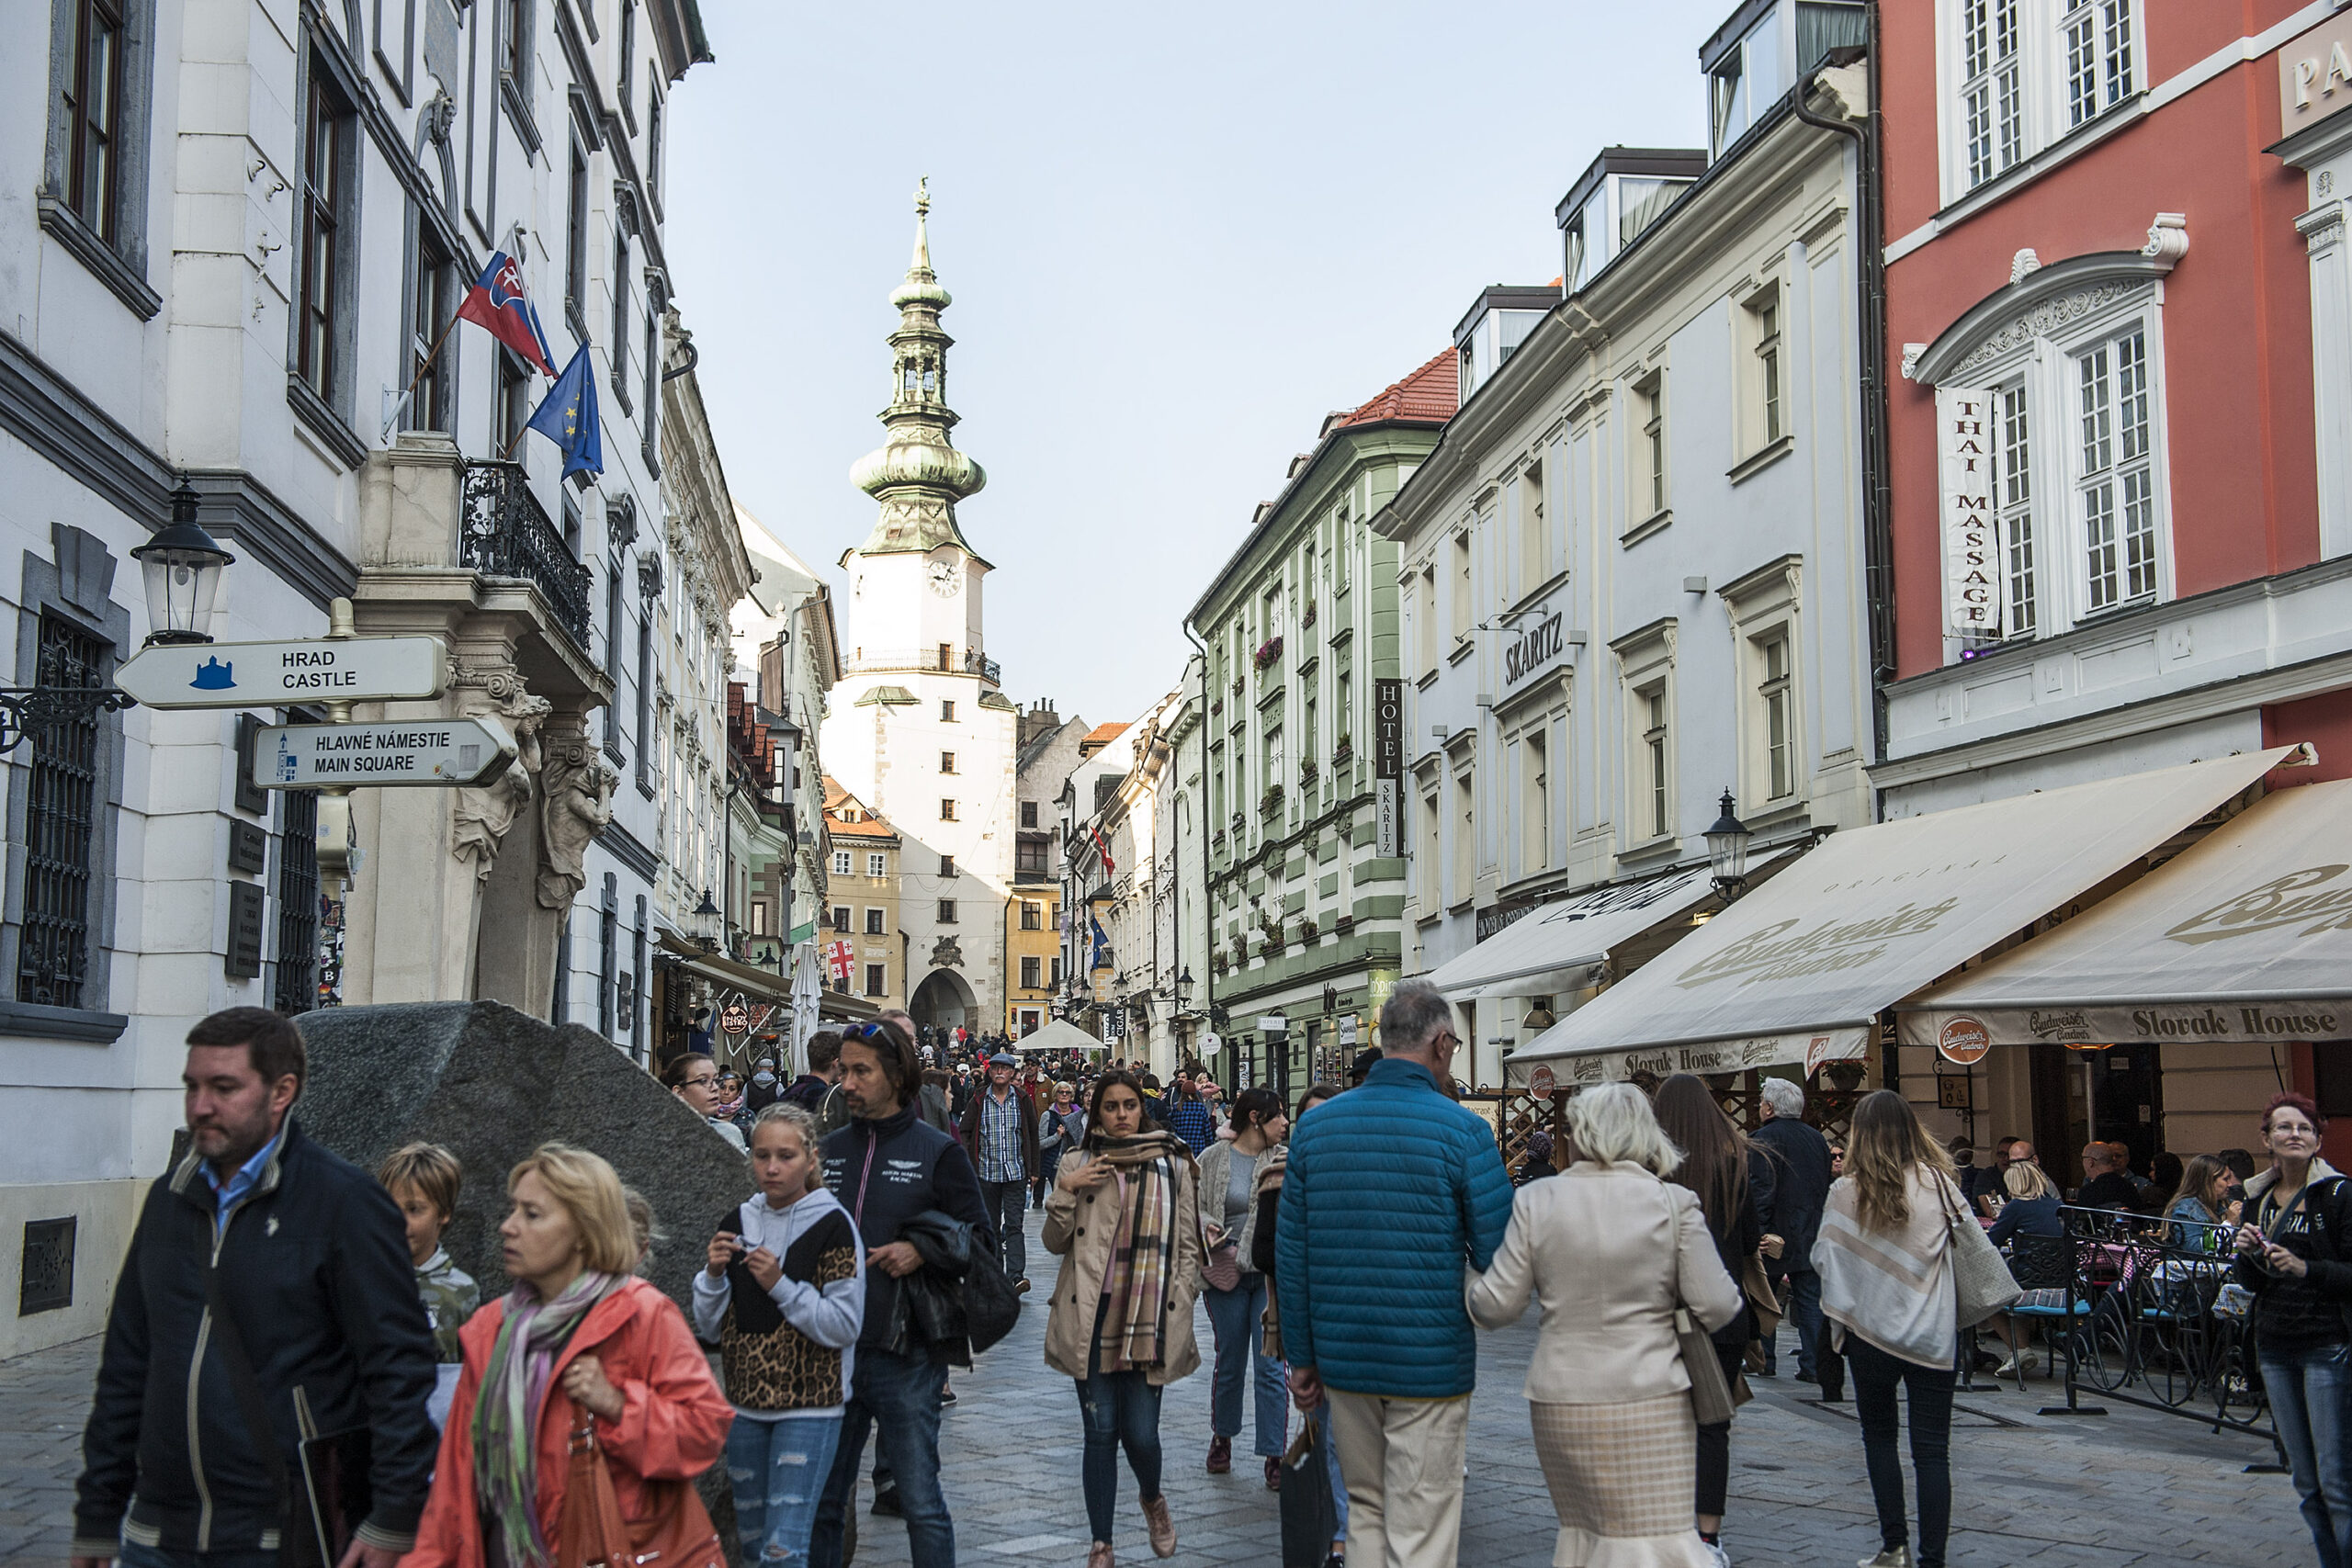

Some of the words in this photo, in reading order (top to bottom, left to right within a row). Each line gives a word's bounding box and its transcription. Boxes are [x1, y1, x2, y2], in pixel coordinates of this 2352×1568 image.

[1955, 400, 1983, 472] THAI
[1957, 494, 1989, 622] MASSAGE
[282, 651, 335, 668] HRAD
[1506, 611, 1562, 686] SKARITZ
[282, 671, 356, 689] CASTLE
[316, 731, 372, 751] HLAVNÉ
[376, 730, 450, 749] NÁMESTIE
[1382, 685, 1396, 775] HOTEL
[315, 757, 350, 773] MAIN
[354, 755, 414, 772] SQUARE
[1383, 784, 1391, 852] SKARITZ
[1115, 1008, 1125, 1037] CIGÁR
[2030, 1010, 2089, 1038] Budweiser
[2132, 1009, 2229, 1036] Slovak
[2239, 1008, 2338, 1034] House
[1942, 1030, 1986, 1048] Budweiser
[1679, 1049, 1721, 1070] House
